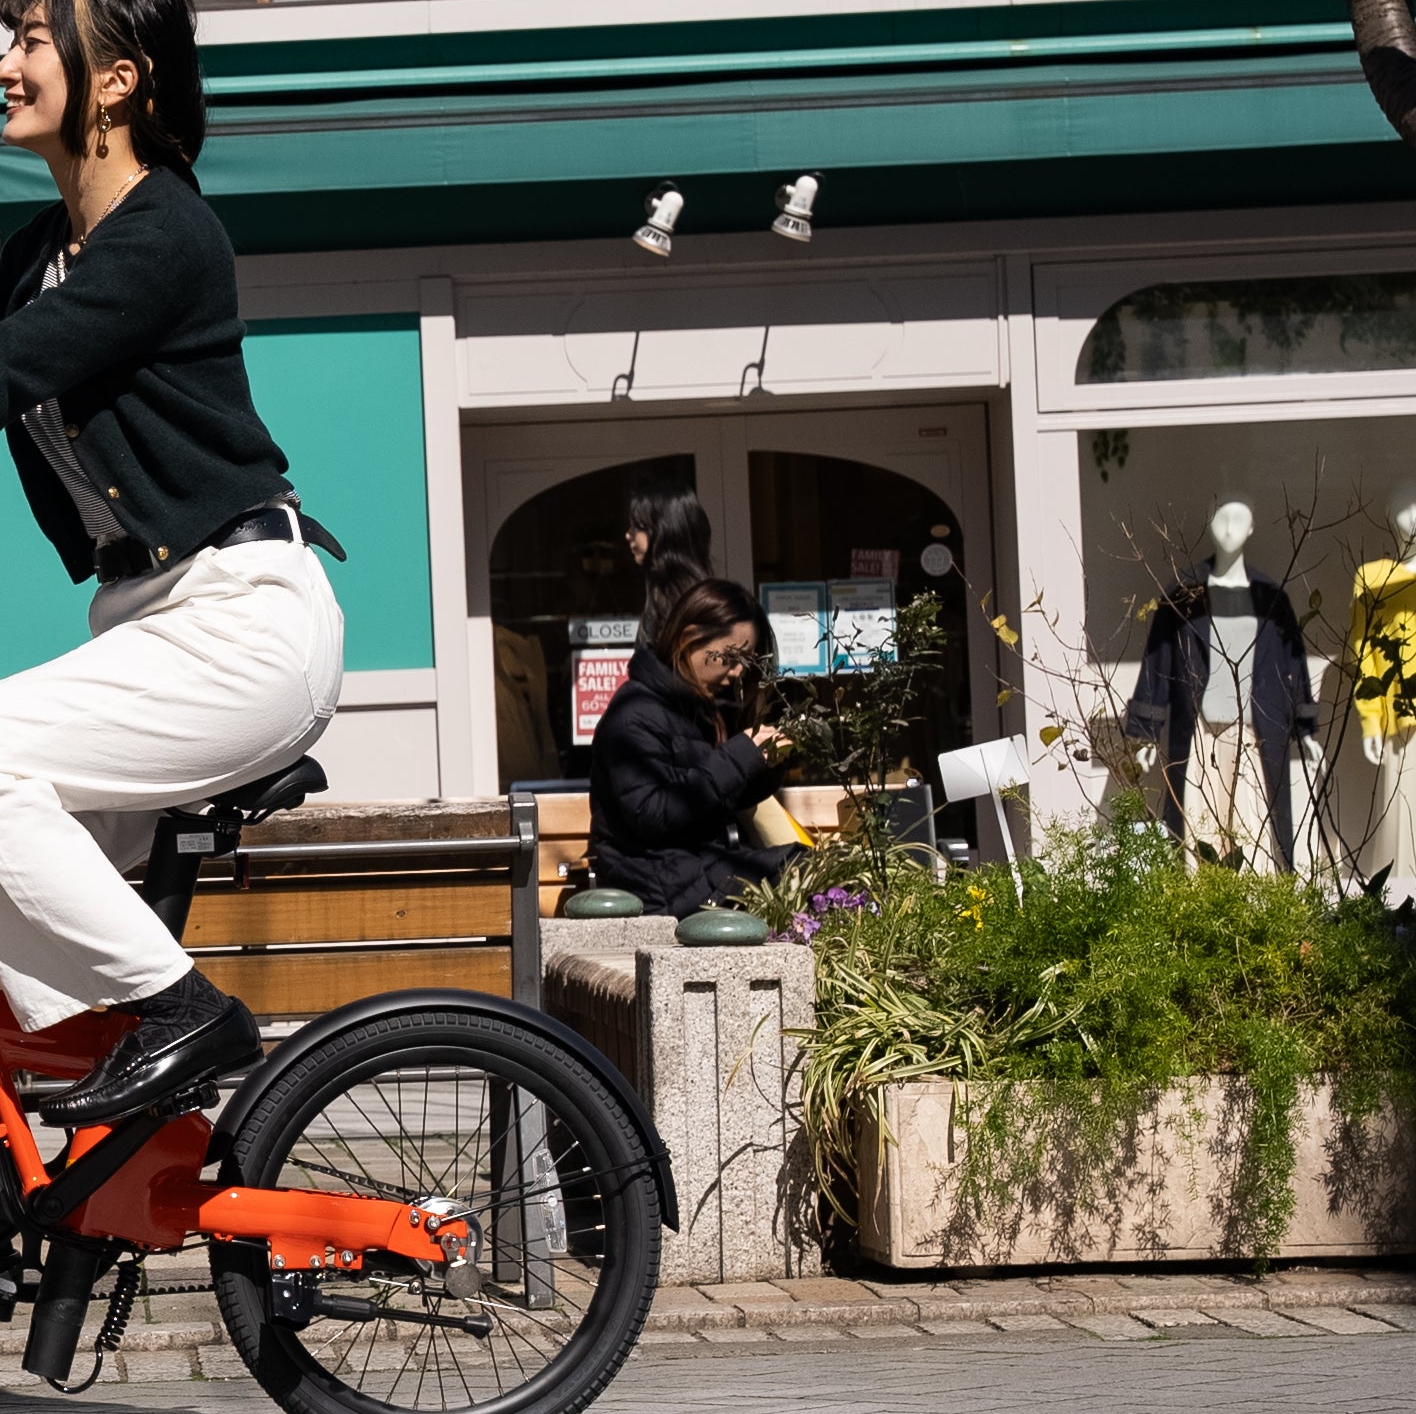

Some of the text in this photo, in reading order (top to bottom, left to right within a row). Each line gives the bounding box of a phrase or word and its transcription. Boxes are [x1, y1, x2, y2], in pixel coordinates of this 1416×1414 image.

[577, 622, 634, 640] CLOSE
[578, 660, 630, 677] FAMILY
[578, 676, 617, 693] SALE!
